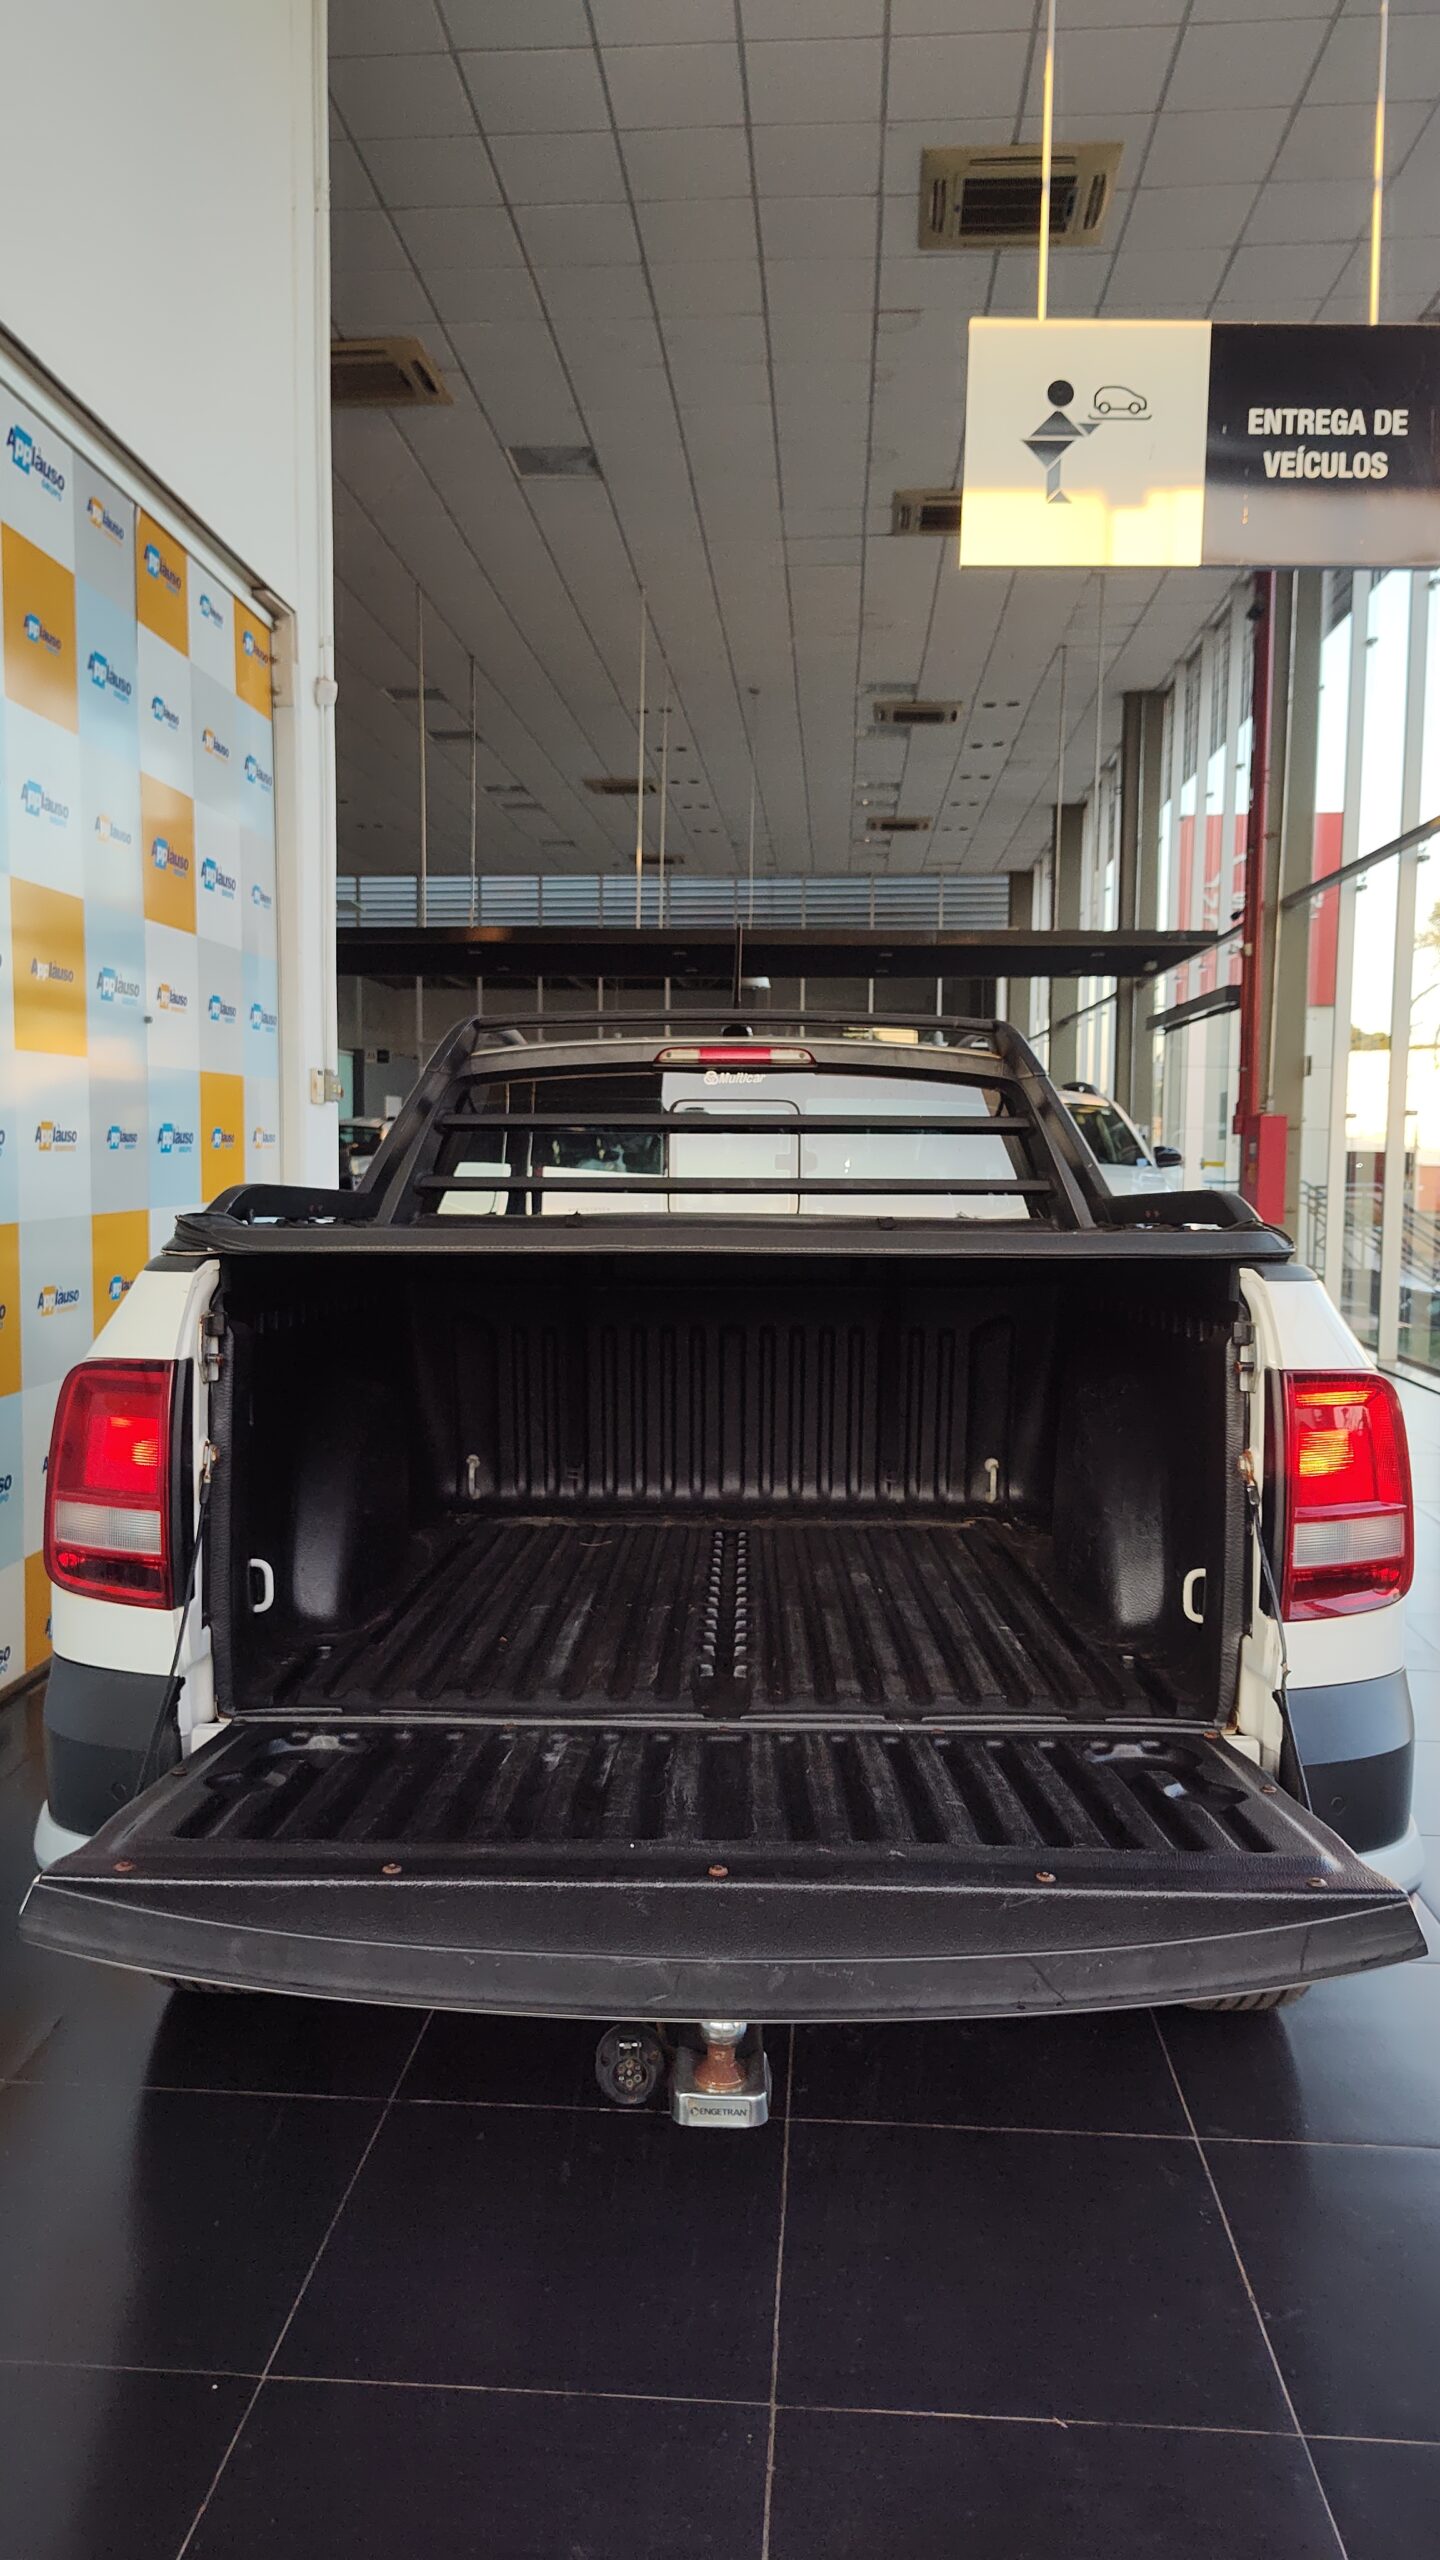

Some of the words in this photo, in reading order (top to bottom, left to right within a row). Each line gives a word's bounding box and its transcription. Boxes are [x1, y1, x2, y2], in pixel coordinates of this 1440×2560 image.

[1248, 408, 1366, 435] ENTREGA
[1374, 409, 1408, 436] DE
[1263, 445, 1388, 479] VEÍCULOS
[718, 1072, 766, 1084] Multicar
[700, 2108, 748, 2117] ENGETRAN
